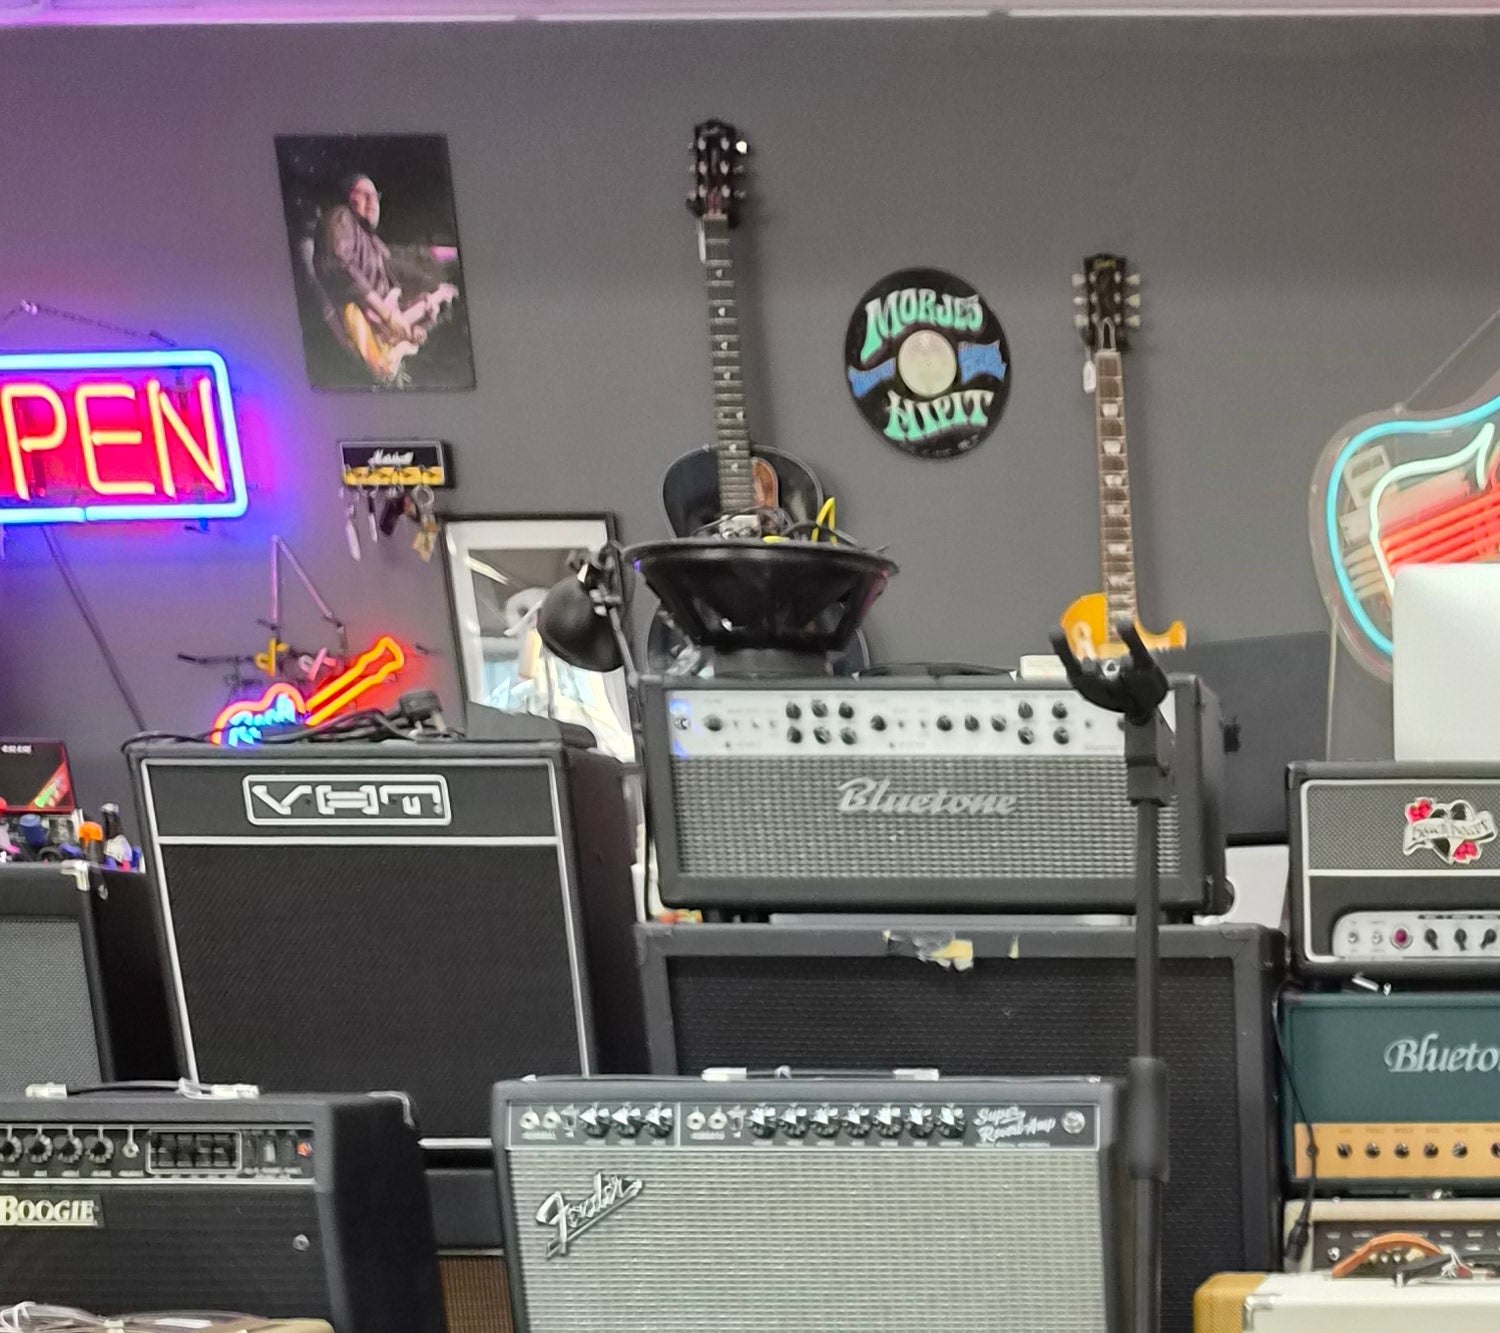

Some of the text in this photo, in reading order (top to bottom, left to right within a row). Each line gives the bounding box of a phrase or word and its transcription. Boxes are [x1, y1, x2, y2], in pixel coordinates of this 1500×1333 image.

[860, 288, 983, 364] MORJES
[1, 376, 225, 500] PEN
[883, 389, 994, 441] HIPIT
[251, 784, 443, 815] VHT
[837, 776, 1018, 815] Bluetone
[0, 1195, 95, 1225] BOOGIE
[536, 1172, 642, 1256] Fender
